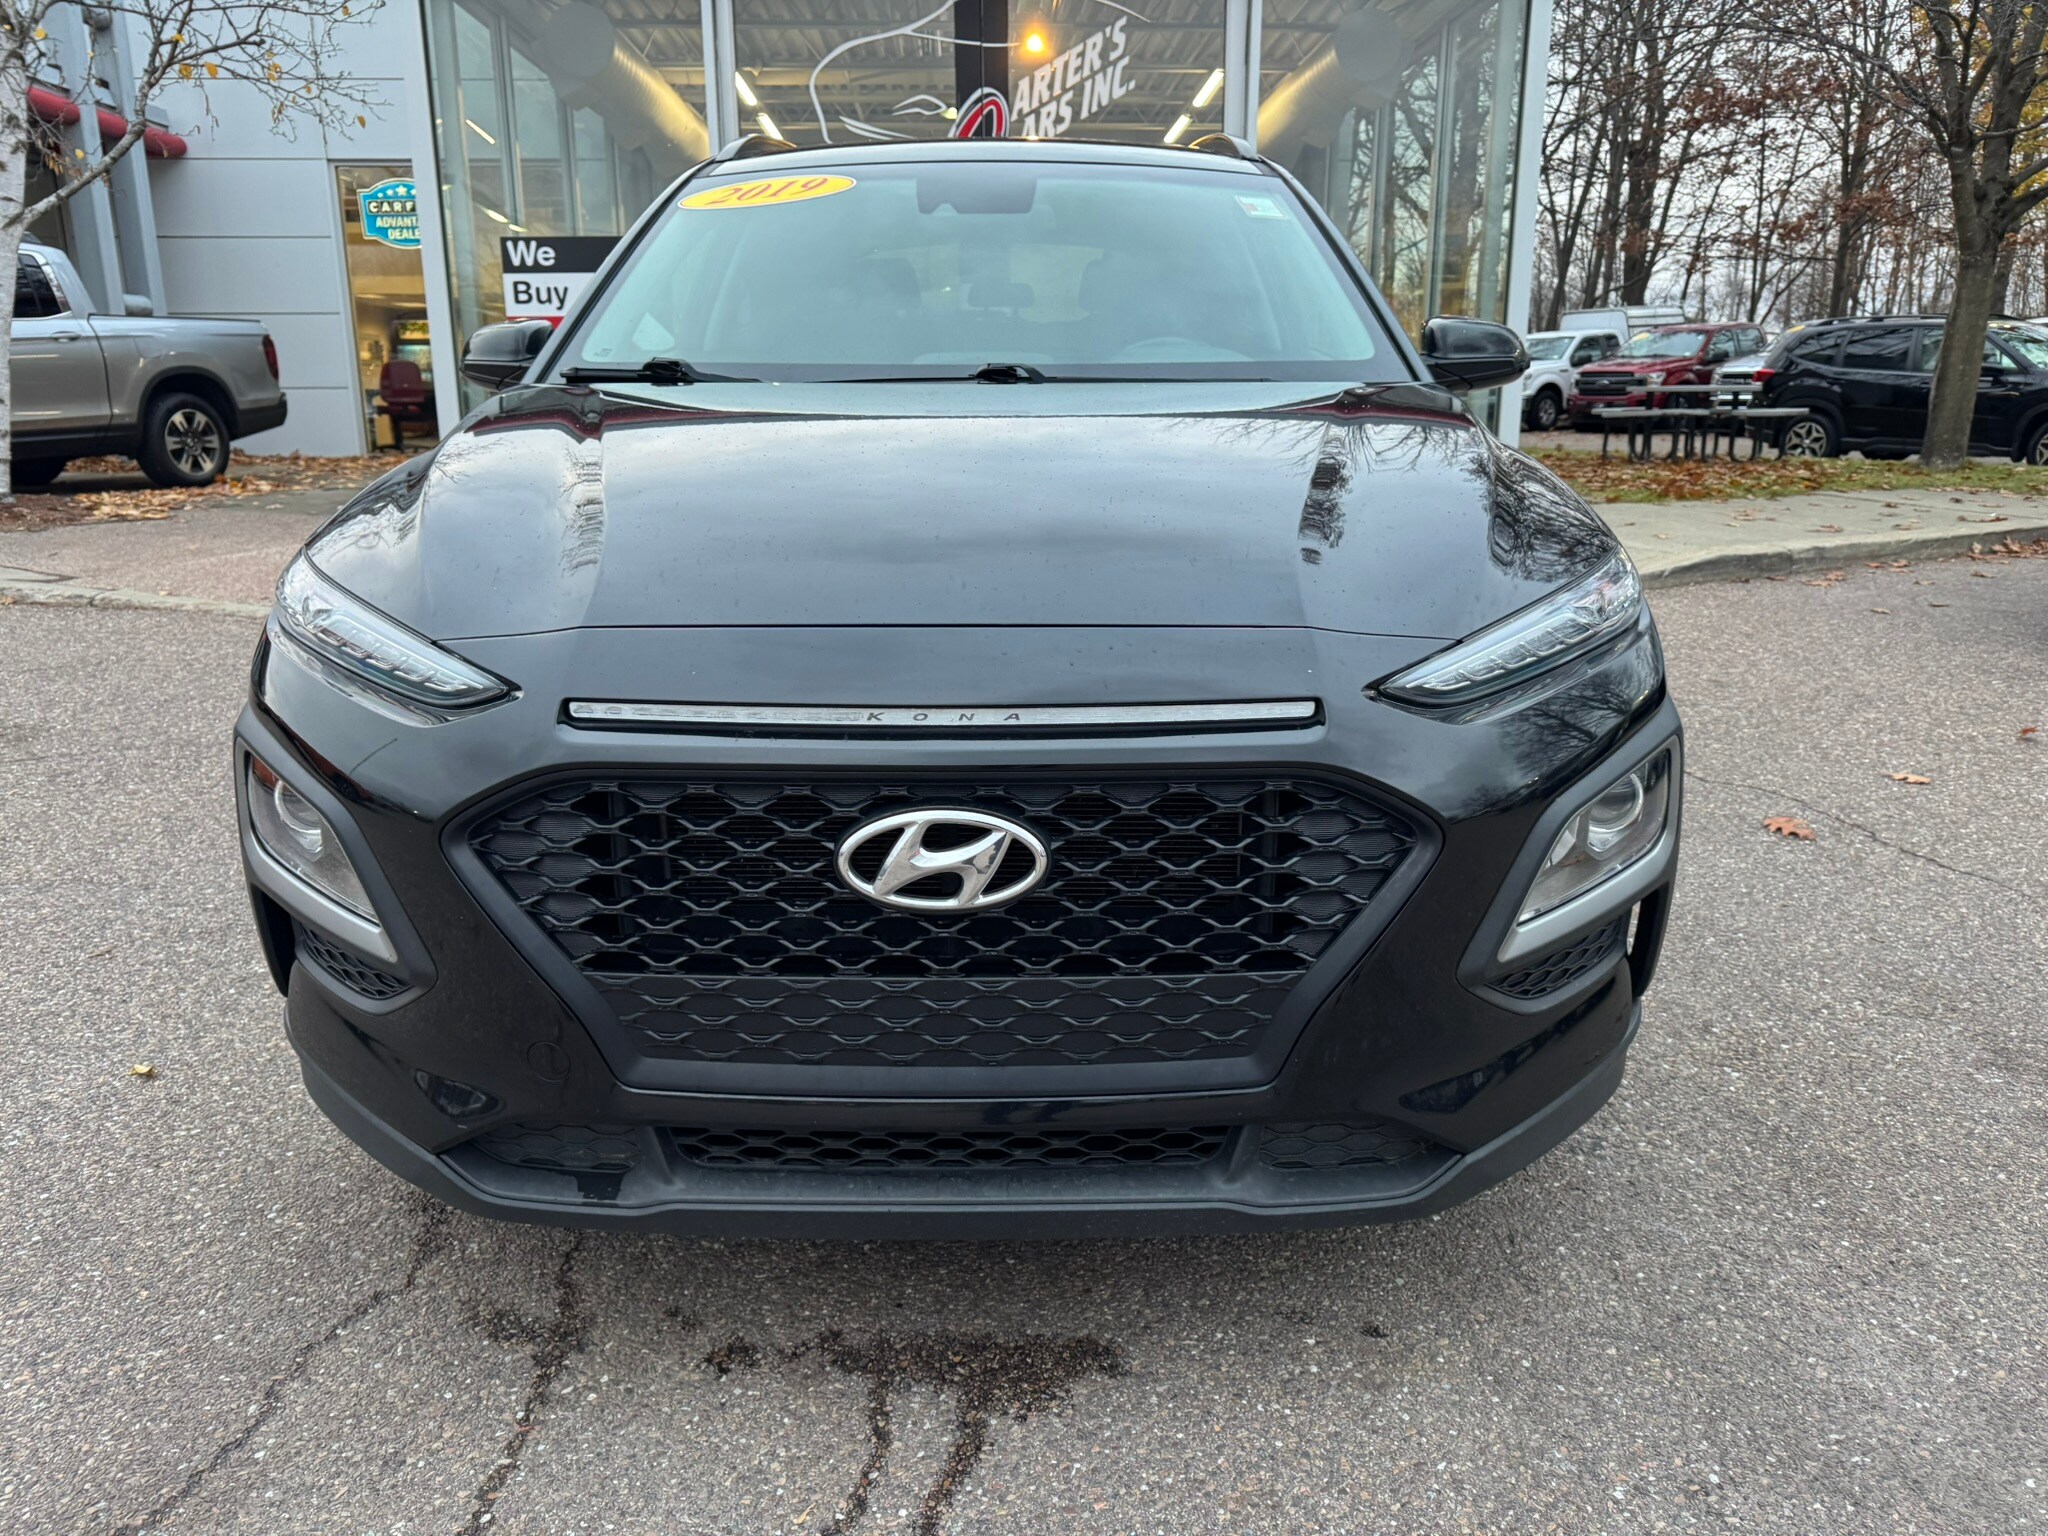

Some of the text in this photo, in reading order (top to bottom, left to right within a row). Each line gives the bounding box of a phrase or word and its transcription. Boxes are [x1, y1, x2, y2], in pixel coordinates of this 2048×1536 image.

[1080, 55, 1137, 120] INC.
[703, 177, 829, 206] 2019
[369, 201, 415, 213] CARF
[375, 216, 418, 229] ADVANT
[387, 228, 421, 240] DEALE
[505, 239, 557, 268] We
[512, 280, 569, 311] Buy
[866, 711, 1021, 722] KONA
